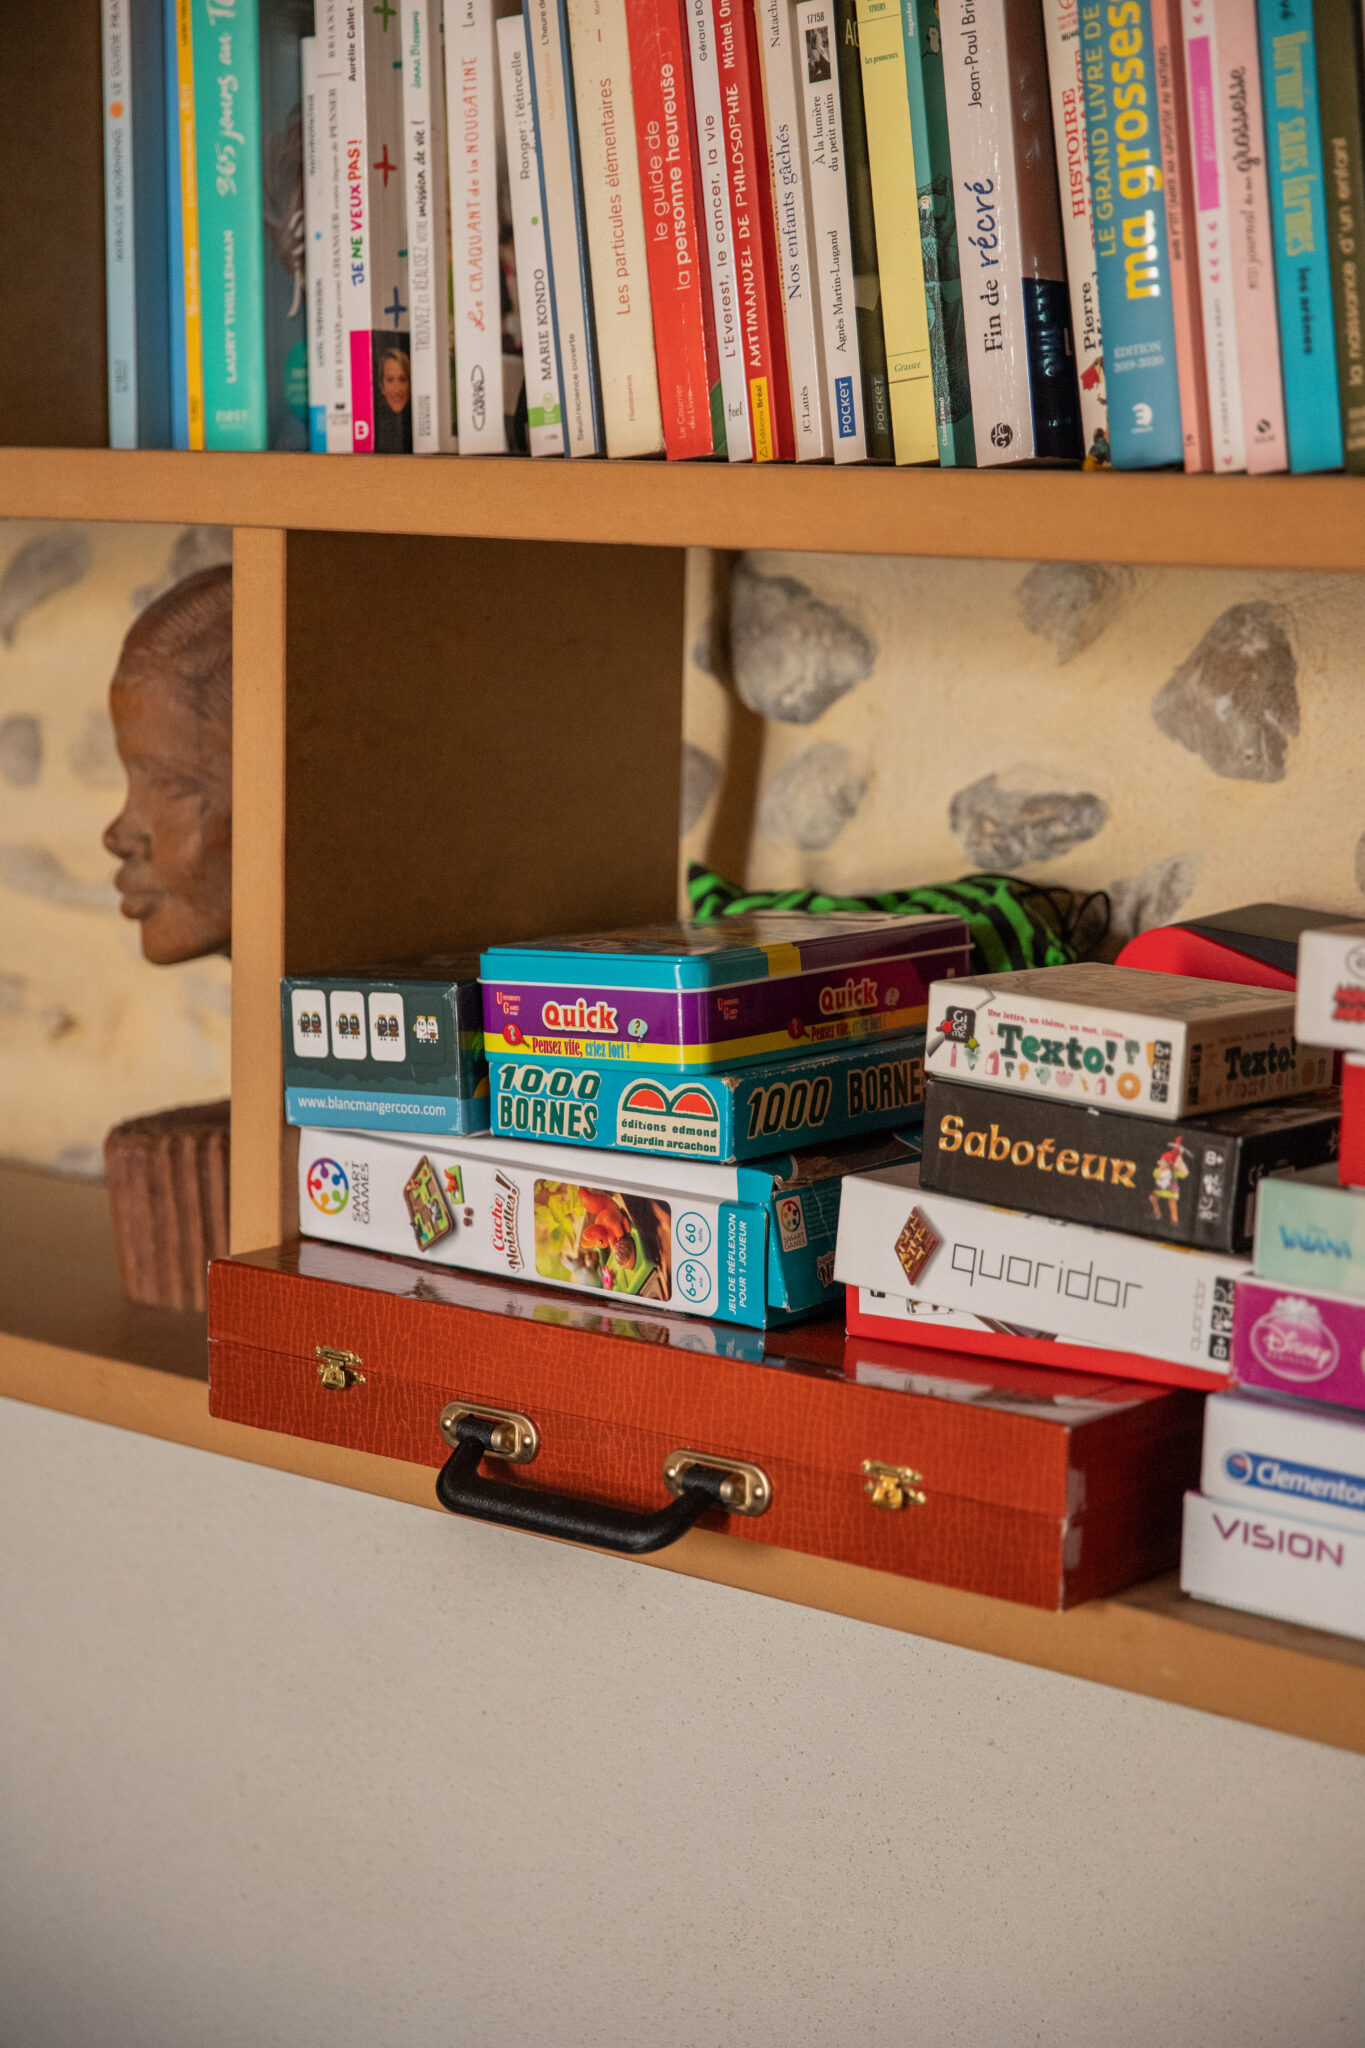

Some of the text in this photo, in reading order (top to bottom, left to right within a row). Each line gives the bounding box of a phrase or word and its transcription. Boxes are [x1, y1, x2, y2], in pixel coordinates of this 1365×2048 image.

[346, 7, 356, 81] Aurélie Callet
[539, 11, 550, 45] L'heure
[696, 20, 707, 61] Gérard
[719, 21, 735, 68] Michel
[806, 12, 825, 24] 17158
[1082, 4, 1101, 40] DE
[960, 30, 982, 108] Jean-Paul
[1085, 45, 1107, 122] LIVRE
[215, 33, 245, 196] 365 jours au
[810, 96, 825, 165] À la lumière
[824, 93, 839, 171] du petit matin
[1229, 66, 1261, 172] grossesse
[517, 128, 533, 180] Ranger
[662, 64, 692, 290] la personne heureuse
[707, 149, 718, 165] la
[776, 124, 798, 185] gâchés
[1062, 87, 1086, 218] HISTOIRE
[1091, 127, 1114, 220] GRAND
[1107, 0, 1163, 300] ma grosses
[1331, 137, 1351, 200] enfant
[350, 184, 363, 231] VEUX
[461, 55, 485, 331] Le CRAQUANT de la NOUGATINE
[598, 78, 631, 315] Les particules élémentaires
[645, 121, 669, 241] le guide de
[709, 172, 726, 243] cancer,
[350, 236, 363, 258] NE
[413, 130, 430, 351] TROUVEZ RÉALISEZ mission de vie
[726, 83, 762, 366] ANTIMANUEL DE PHILOSOPHIE
[782, 191, 797, 258] enfants
[1098, 226, 1117, 256] LE
[351, 263, 365, 286] JE
[715, 251, 727, 266] le
[787, 264, 802, 300] Nos
[964, 178, 1003, 353] Fin de récré
[223, 230, 237, 383] LAURY THILLEMAN
[533, 269, 548, 326] KONDO
[720, 274, 735, 357] L'Everest,
[826, 230, 847, 352] Agnès Martin-Lugand
[1080, 281, 1096, 352] Pierre
[1343, 261, 1361, 359] naissance
[538, 331, 552, 380] MARIE
[894, 362, 921, 372] Grasset
[1348, 365, 1363, 386] la
[568, 334, 584, 441] Seuil/science ouverte
[626, 374, 635, 421] Flammarion
[675, 385, 687, 439] Le Courrier
[755, 385, 767, 444] Éditions Bréal
[801, 386, 812, 433] JC Lattès
[542, 998, 618, 1032] Quick
[819, 978, 878, 1015] Quick
[987, 1008, 1001, 1018] Une
[532, 1037, 624, 1059] Pensez vite, criez fort
[997, 1023, 1119, 1077] Texto!
[1224, 1036, 1297, 1081] Texto!
[298, 1096, 446, 1116] www.blancmangercoco.com
[498, 1063, 601, 1101] 1000
[747, 1076, 832, 1140] 1000
[498, 1093, 599, 1142] BORNES
[621, 1134, 716, 1153] dujardin arcachon
[622, 1119, 717, 1138] éditions edmond
[938, 1114, 1136, 1188] Saboteur
[351, 1160, 361, 1222] SMART
[361, 1162, 371, 1225] GAMES
[492, 1195, 504, 1251] Cache
[685, 1223, 695, 1244] 60
[685, 1264, 697, 1297] 6-99
[726, 1213, 737, 1315] JEU DE RÉFLEXION
[738, 1220, 747, 1308] POUR JOUEUR
[951, 1243, 1143, 1310] quoridor
[1211, 1513, 1344, 1567] VISION
